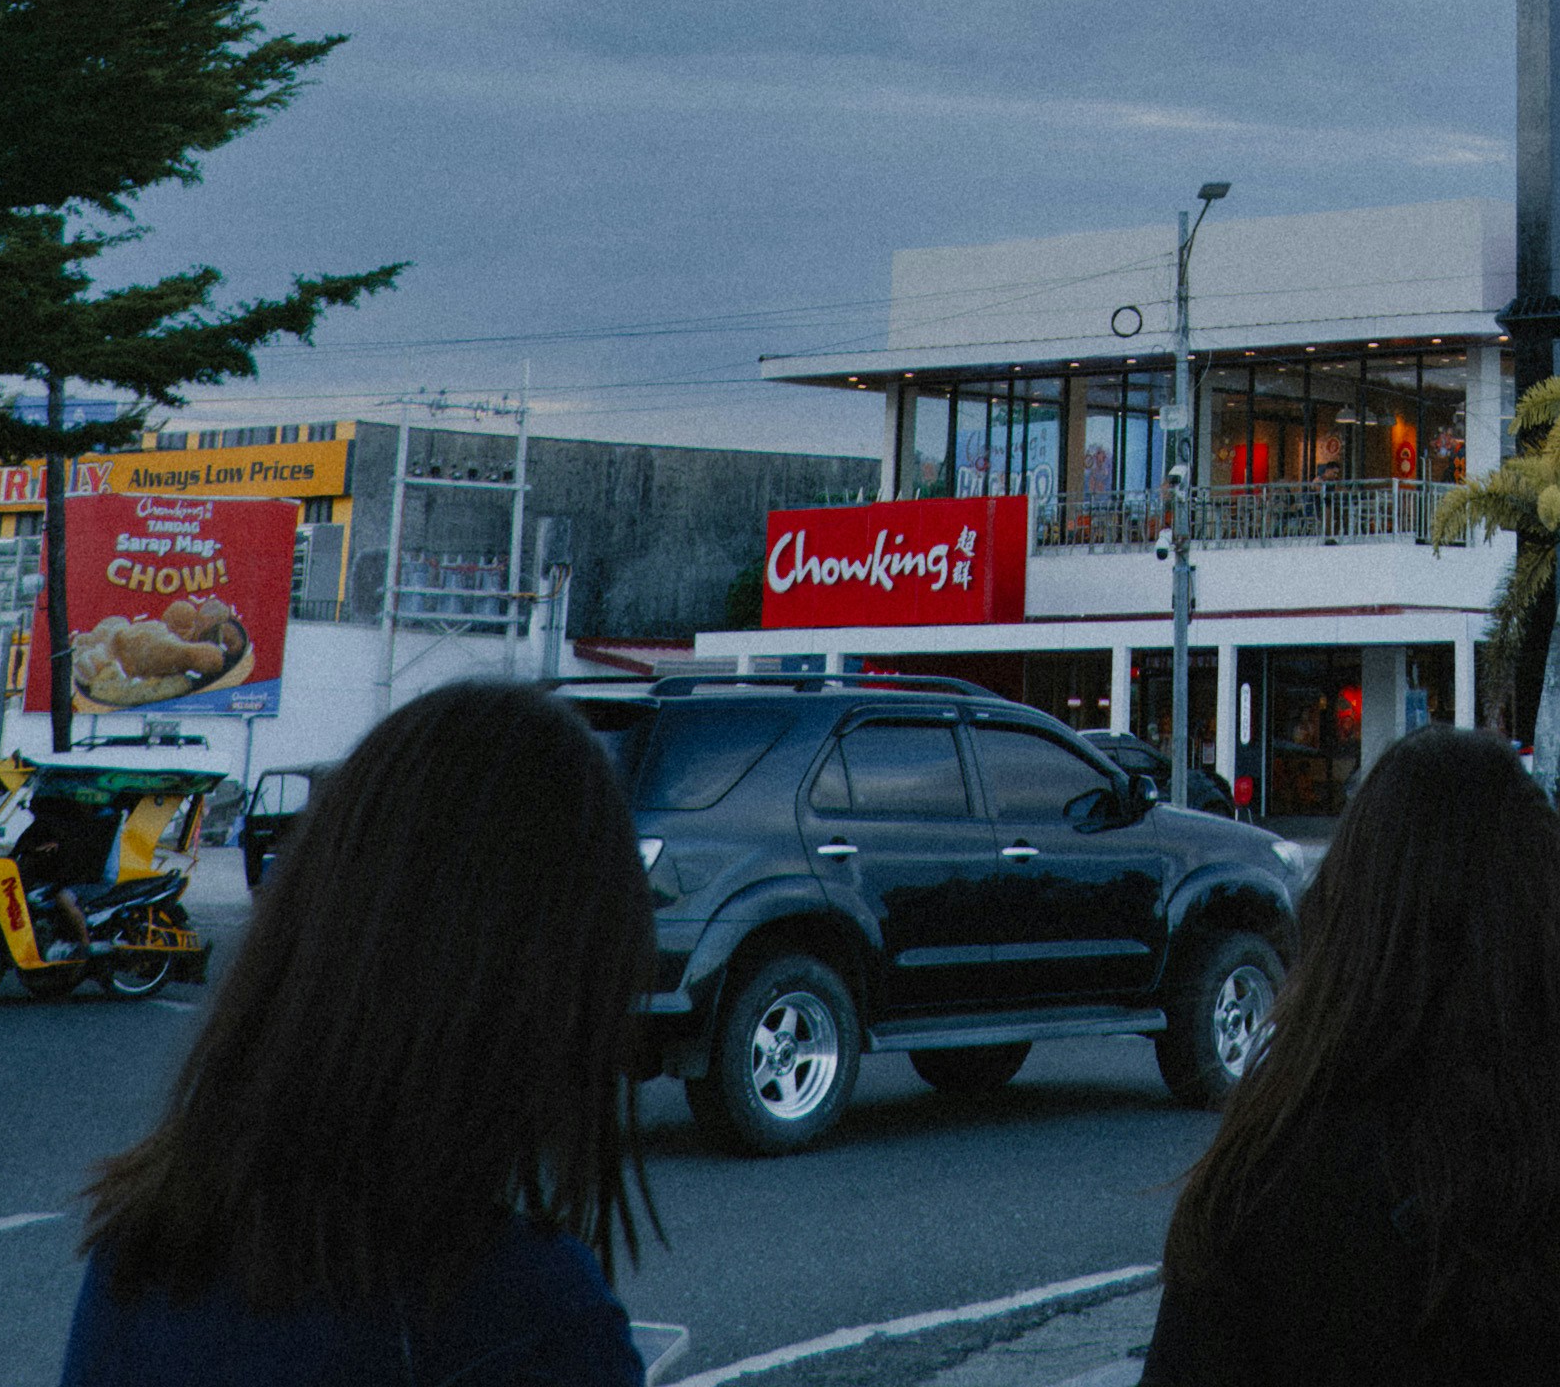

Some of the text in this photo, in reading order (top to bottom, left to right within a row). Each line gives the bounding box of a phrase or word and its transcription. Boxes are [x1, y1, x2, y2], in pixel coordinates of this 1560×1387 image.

[129, 460, 316, 491] Always Low Prices
[136, 497, 204, 520] Chowking
[147, 520, 201, 534] TANDAG
[115, 533, 222, 558] Sarap Mag-
[106, 557, 230, 594] CHOW!
[767, 529, 950, 594] Chowking
